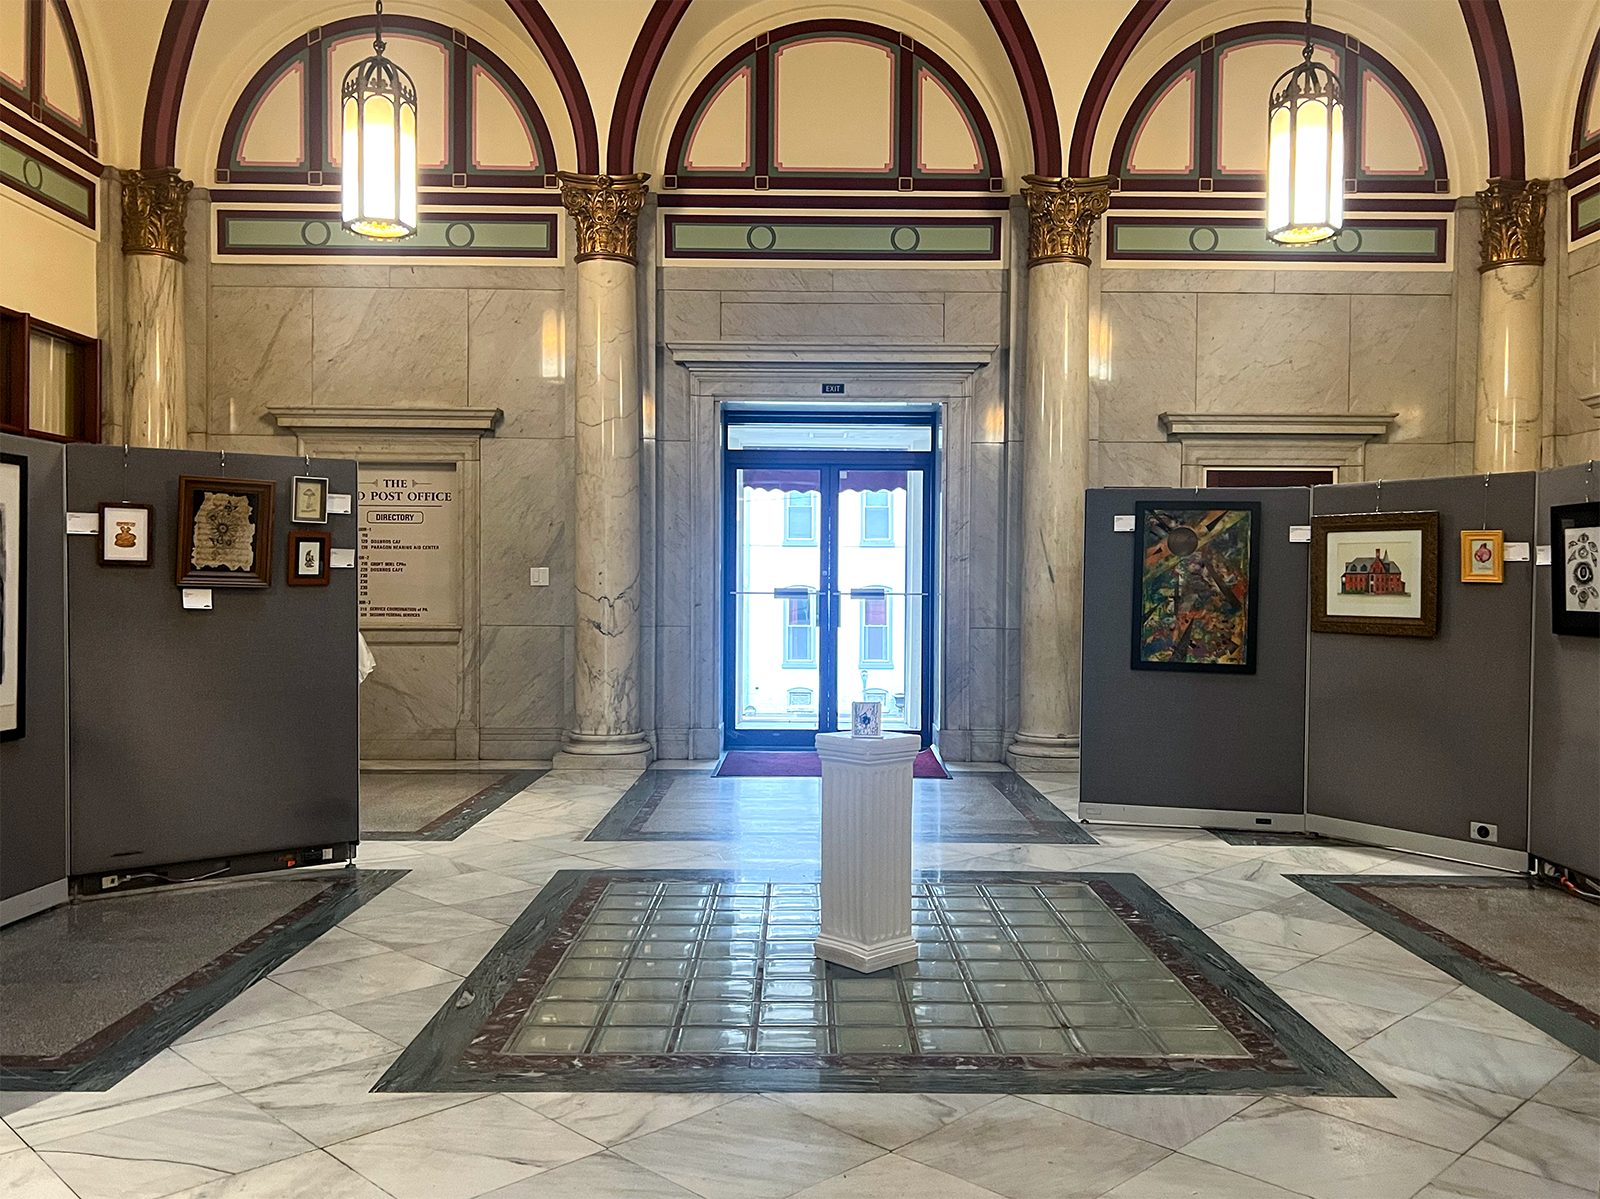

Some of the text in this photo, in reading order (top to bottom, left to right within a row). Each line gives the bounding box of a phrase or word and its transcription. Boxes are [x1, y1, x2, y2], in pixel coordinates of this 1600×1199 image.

[382, 479, 408, 488] THE
[370, 492, 403, 501] POST
[407, 492, 452, 502] OFFICE
[376, 513, 414, 522] DIRECTORY
